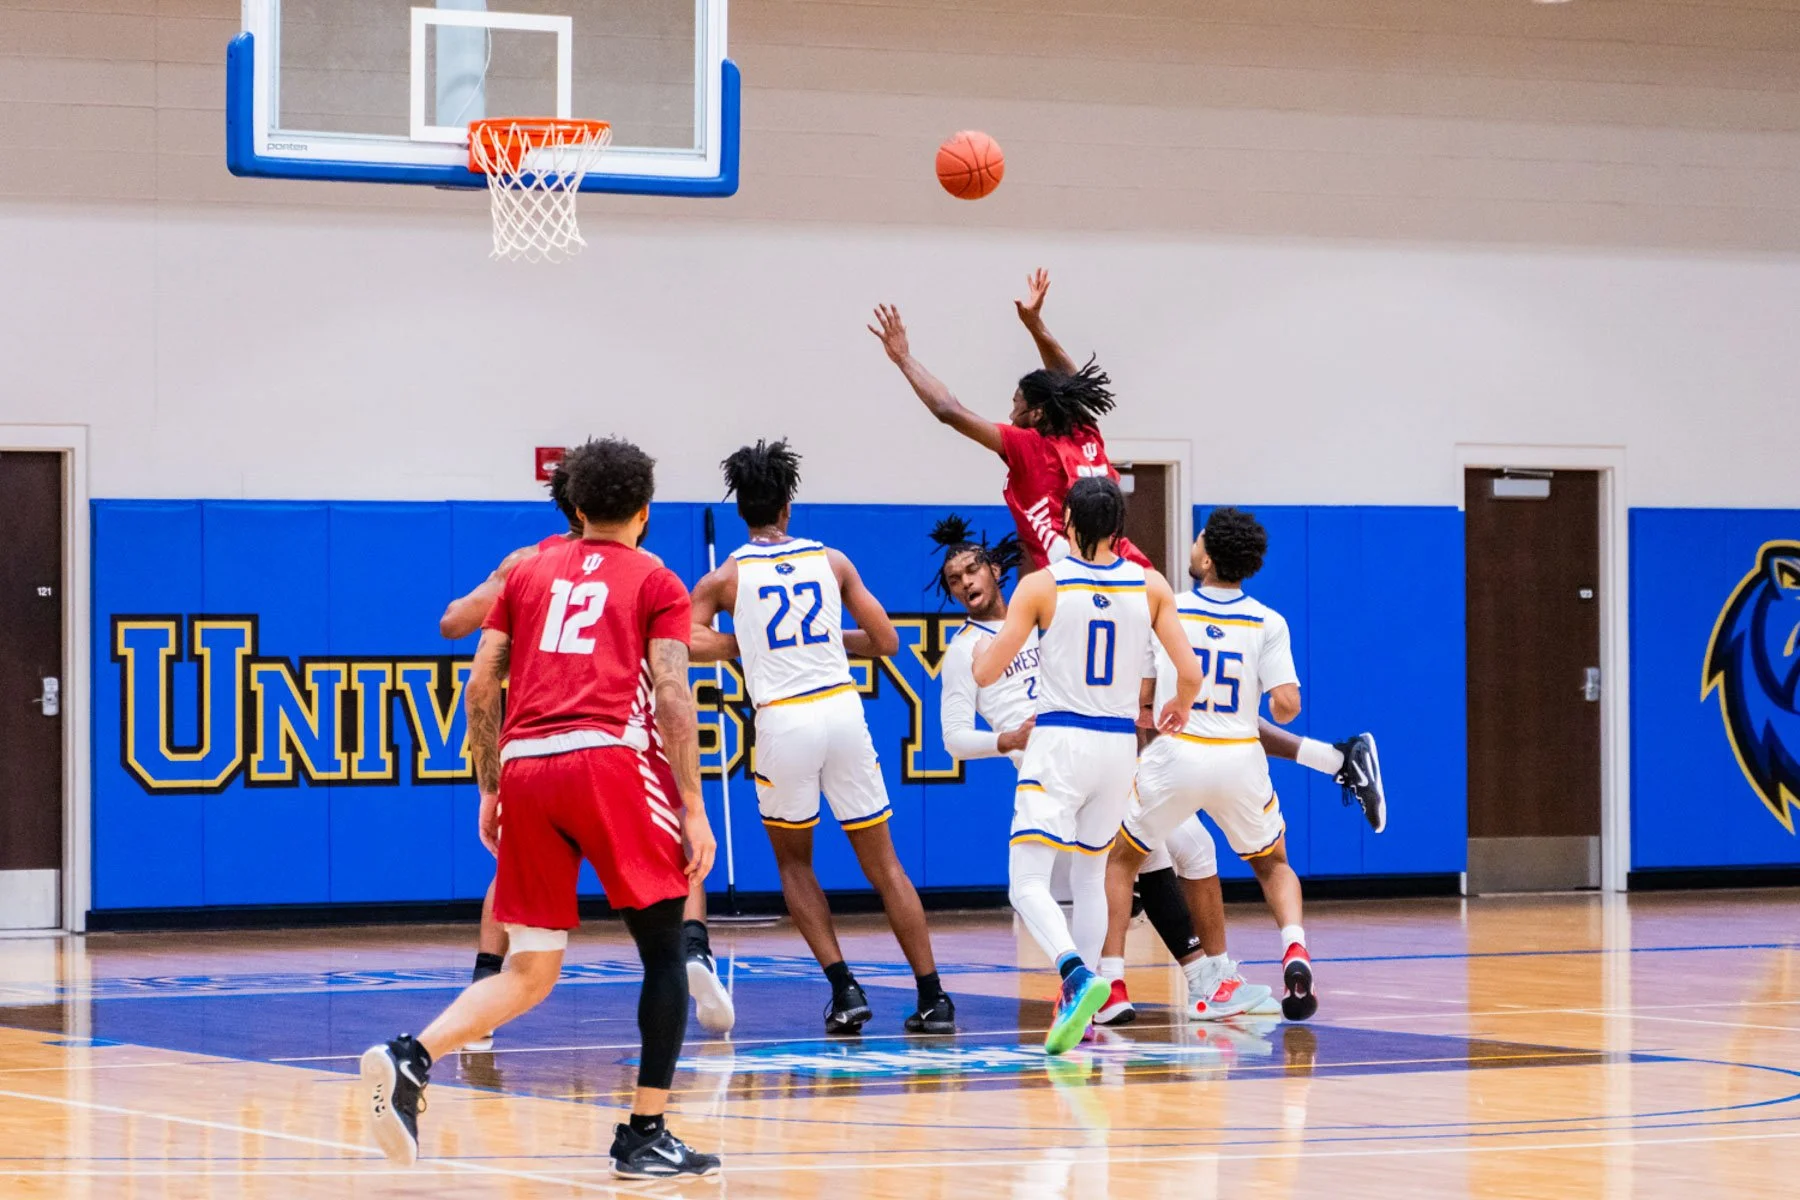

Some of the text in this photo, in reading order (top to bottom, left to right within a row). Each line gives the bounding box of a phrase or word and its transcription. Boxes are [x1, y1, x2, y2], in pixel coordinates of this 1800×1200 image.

[37, 587, 51, 596] 121
[539, 578, 609, 654] 12
[758, 581, 830, 651] 22
[1086, 619, 1116, 687] 0
[110, 613, 966, 796] UNIVSY
